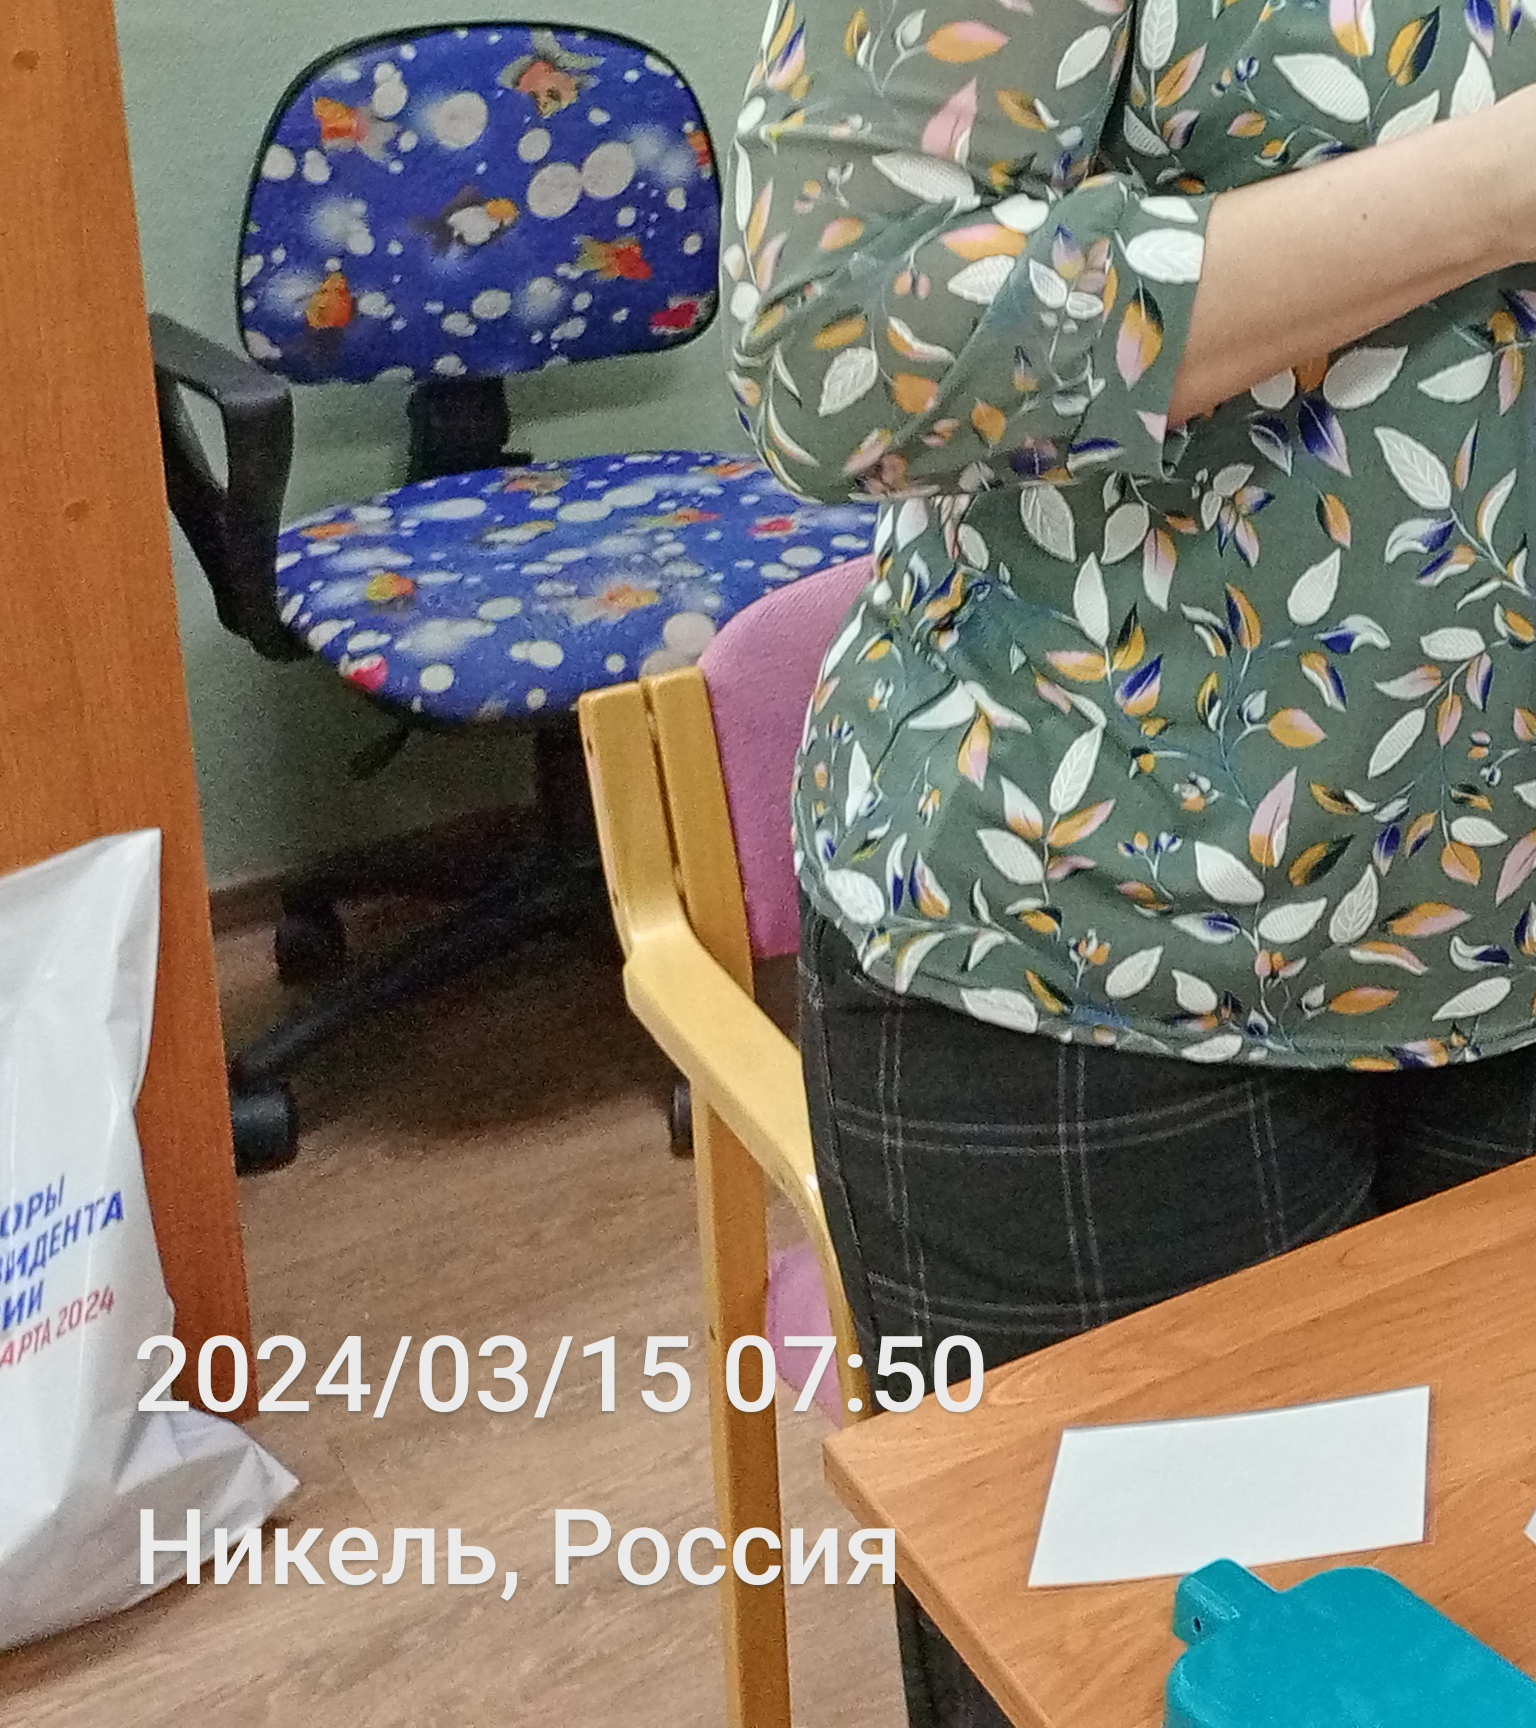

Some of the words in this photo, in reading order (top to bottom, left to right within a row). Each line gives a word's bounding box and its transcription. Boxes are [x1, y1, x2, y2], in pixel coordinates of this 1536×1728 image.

[0, 1172, 65, 1239] ОРЫ
[0, 1190, 125, 1285] ИДЕНТА
[0, 1316, 52, 1369] АРТА
[55, 1284, 116, 1340] 2024
